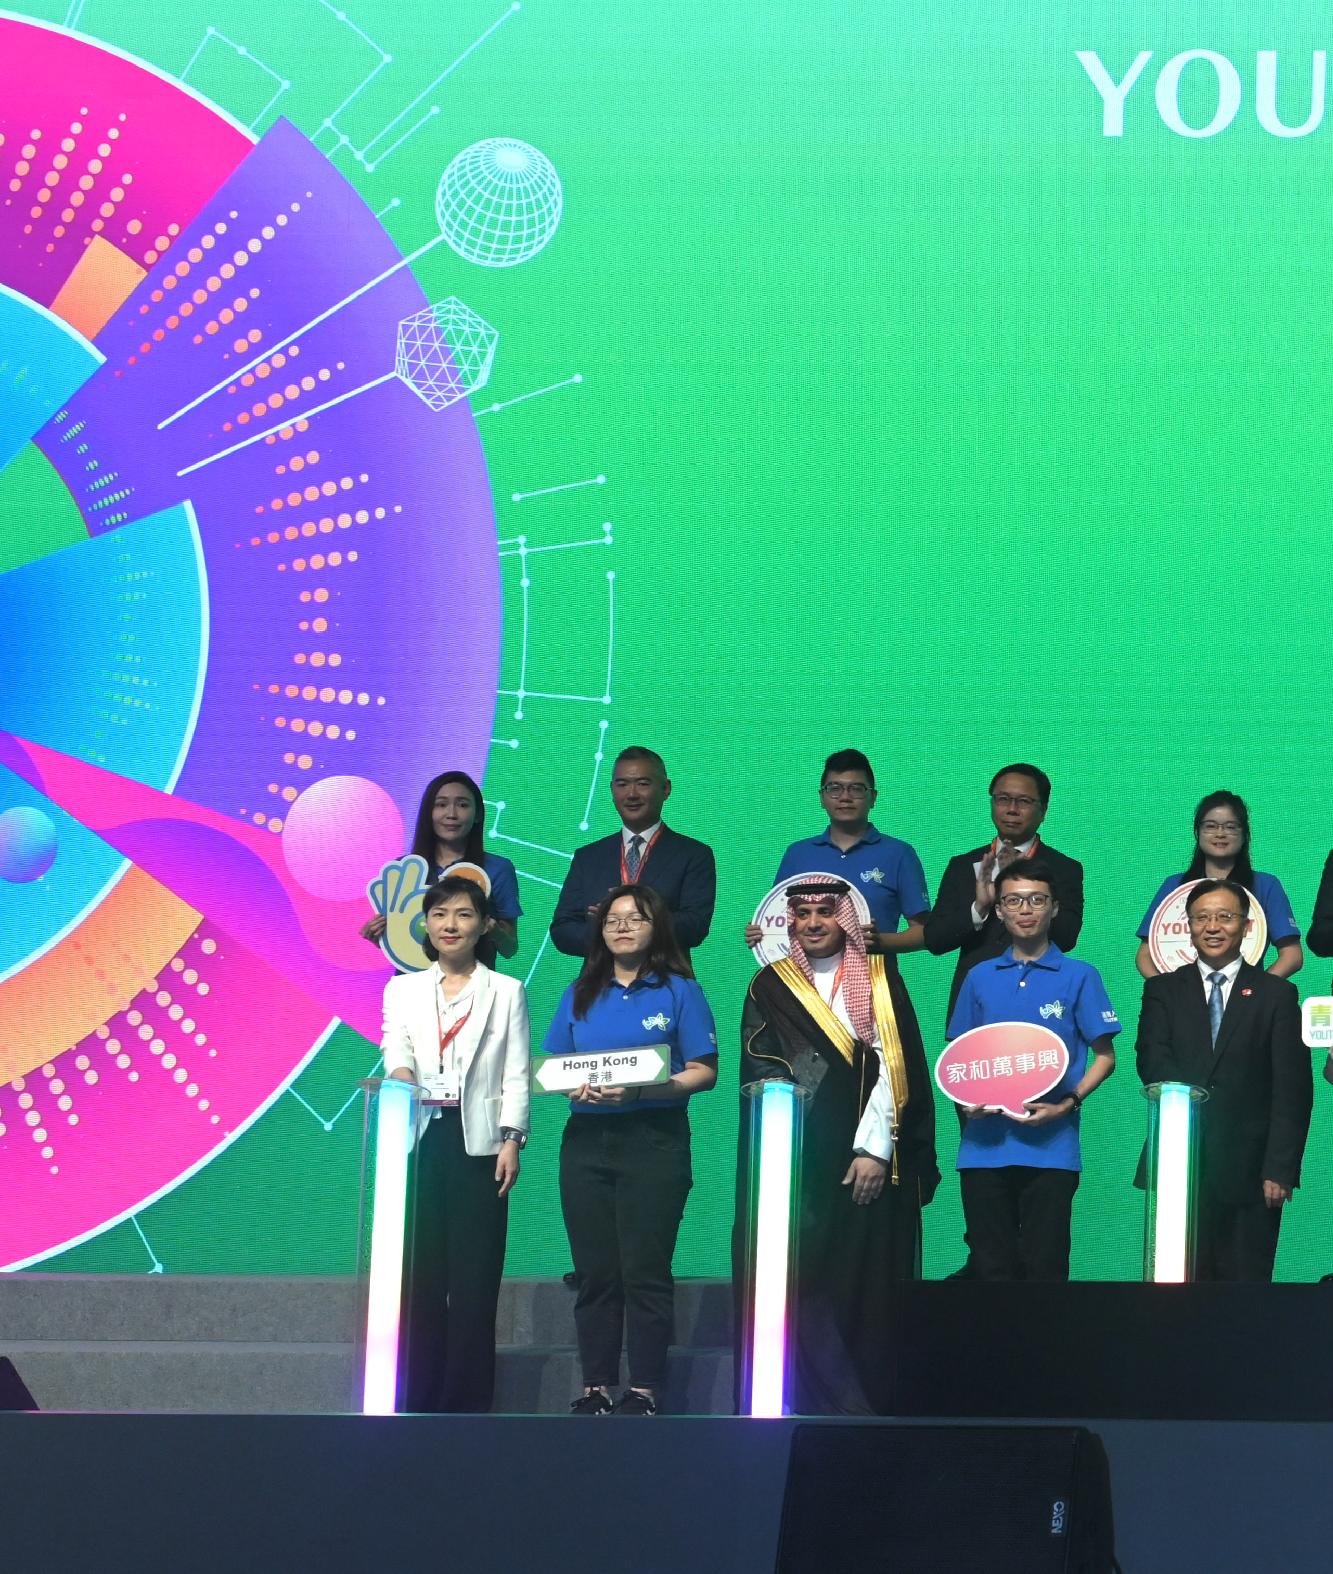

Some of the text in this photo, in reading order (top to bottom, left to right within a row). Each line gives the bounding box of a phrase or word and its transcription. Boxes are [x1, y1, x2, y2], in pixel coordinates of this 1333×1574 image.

[562, 1055, 638, 1071] Hong Kong
[946, 1048, 1060, 1084] 家和萬事興
[587, 1071, 613, 1084] 香港
[1051, 1501, 1065, 1534] NEXO
